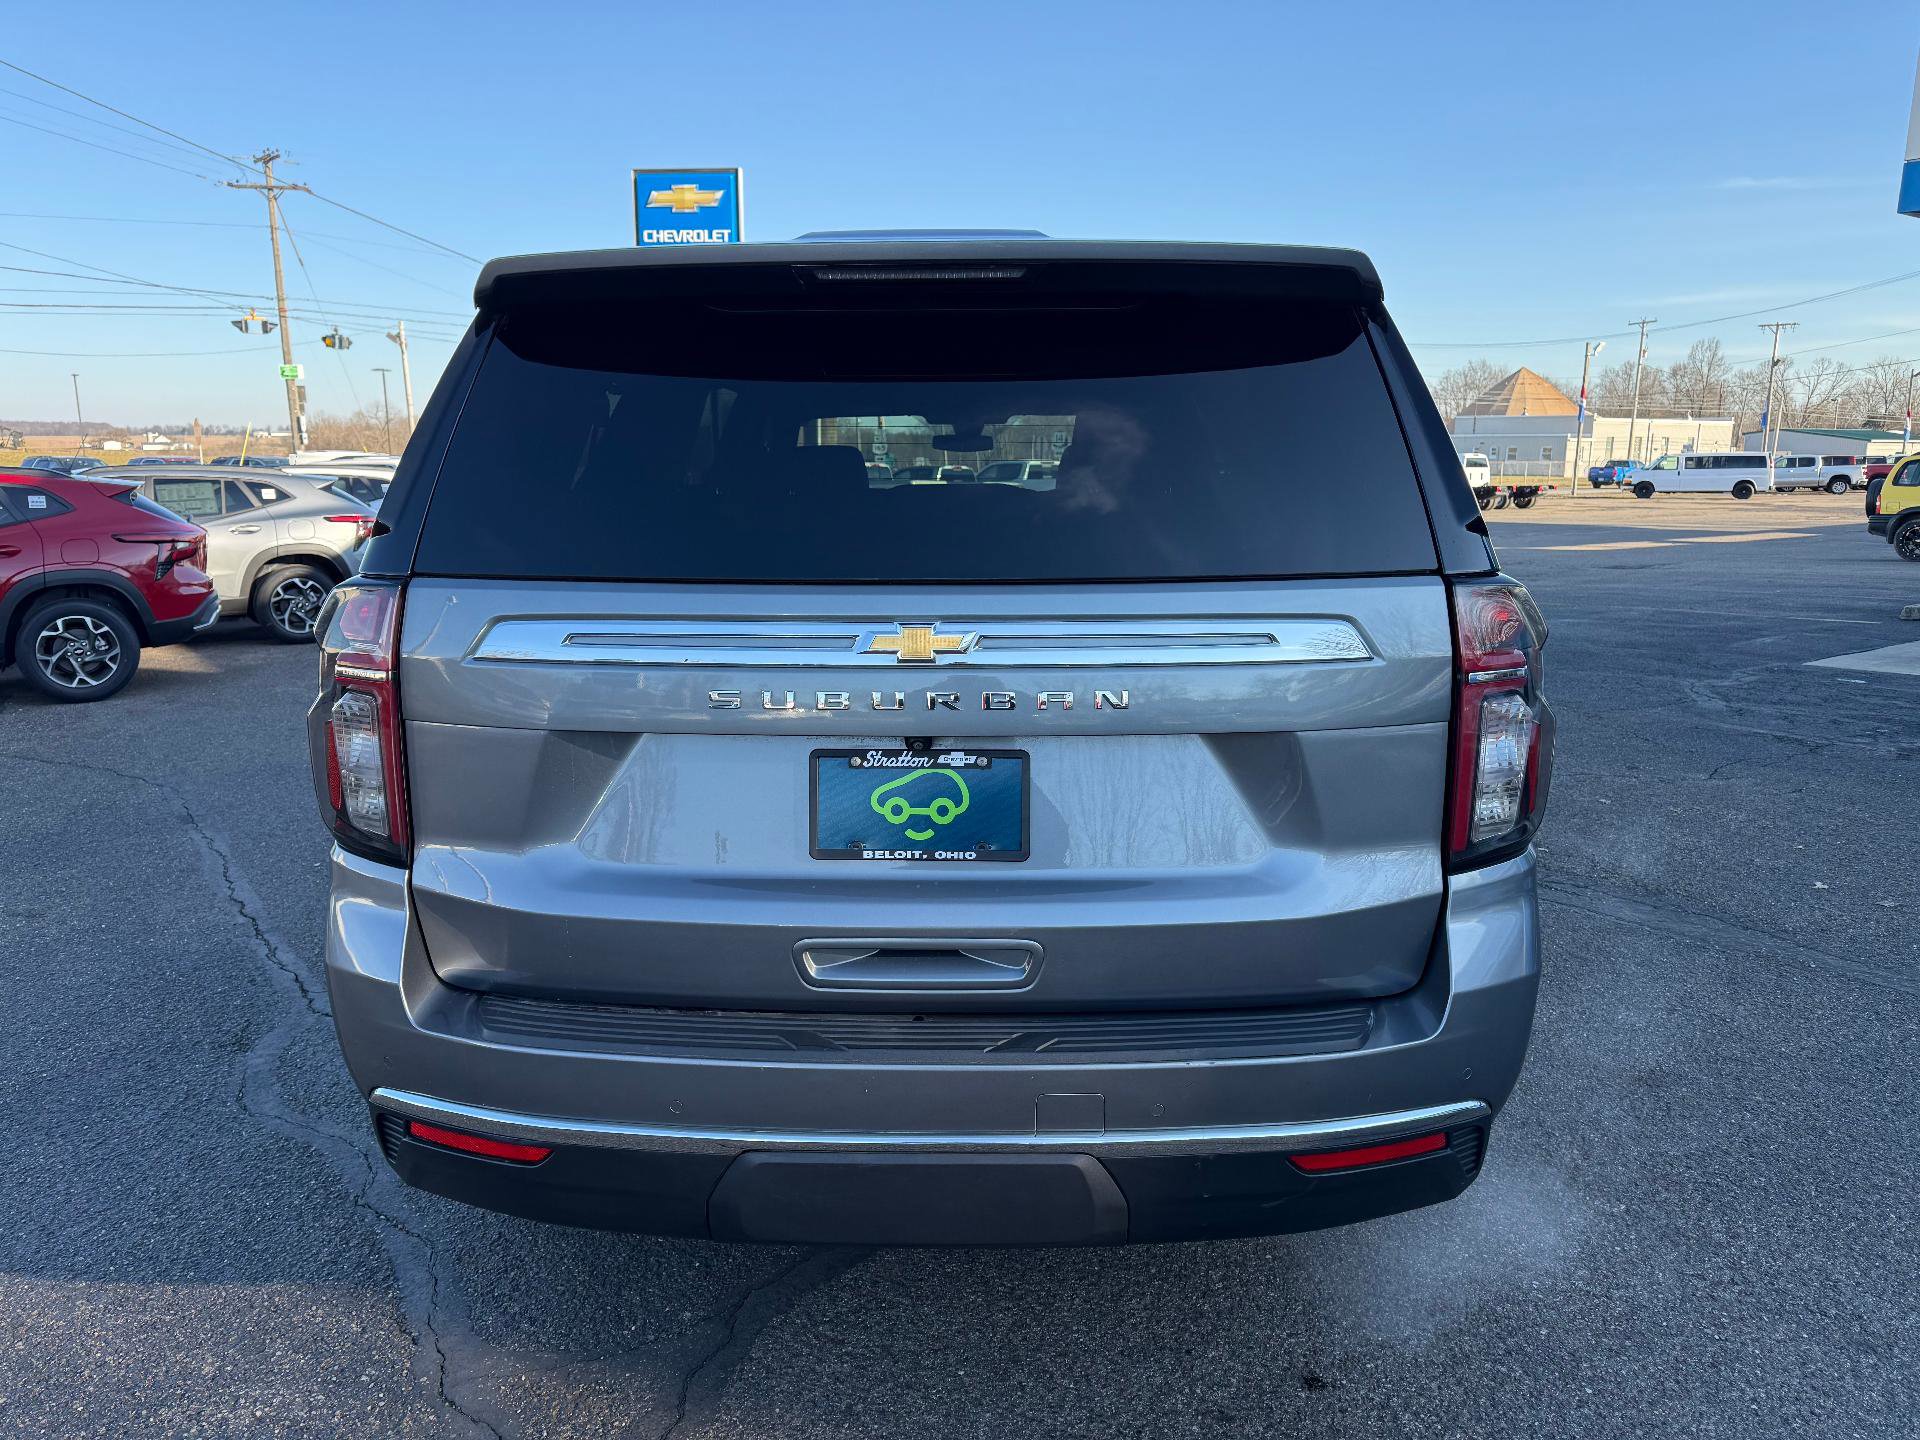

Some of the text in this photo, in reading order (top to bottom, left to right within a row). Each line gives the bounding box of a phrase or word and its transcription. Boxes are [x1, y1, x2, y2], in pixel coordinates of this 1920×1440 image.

[643, 229, 731, 243] CHEVROLET
[708, 689, 1129, 711] SUBURBAN
[862, 750, 934, 768] Stratton
[863, 850, 977, 860] BELOIT, OHIO
